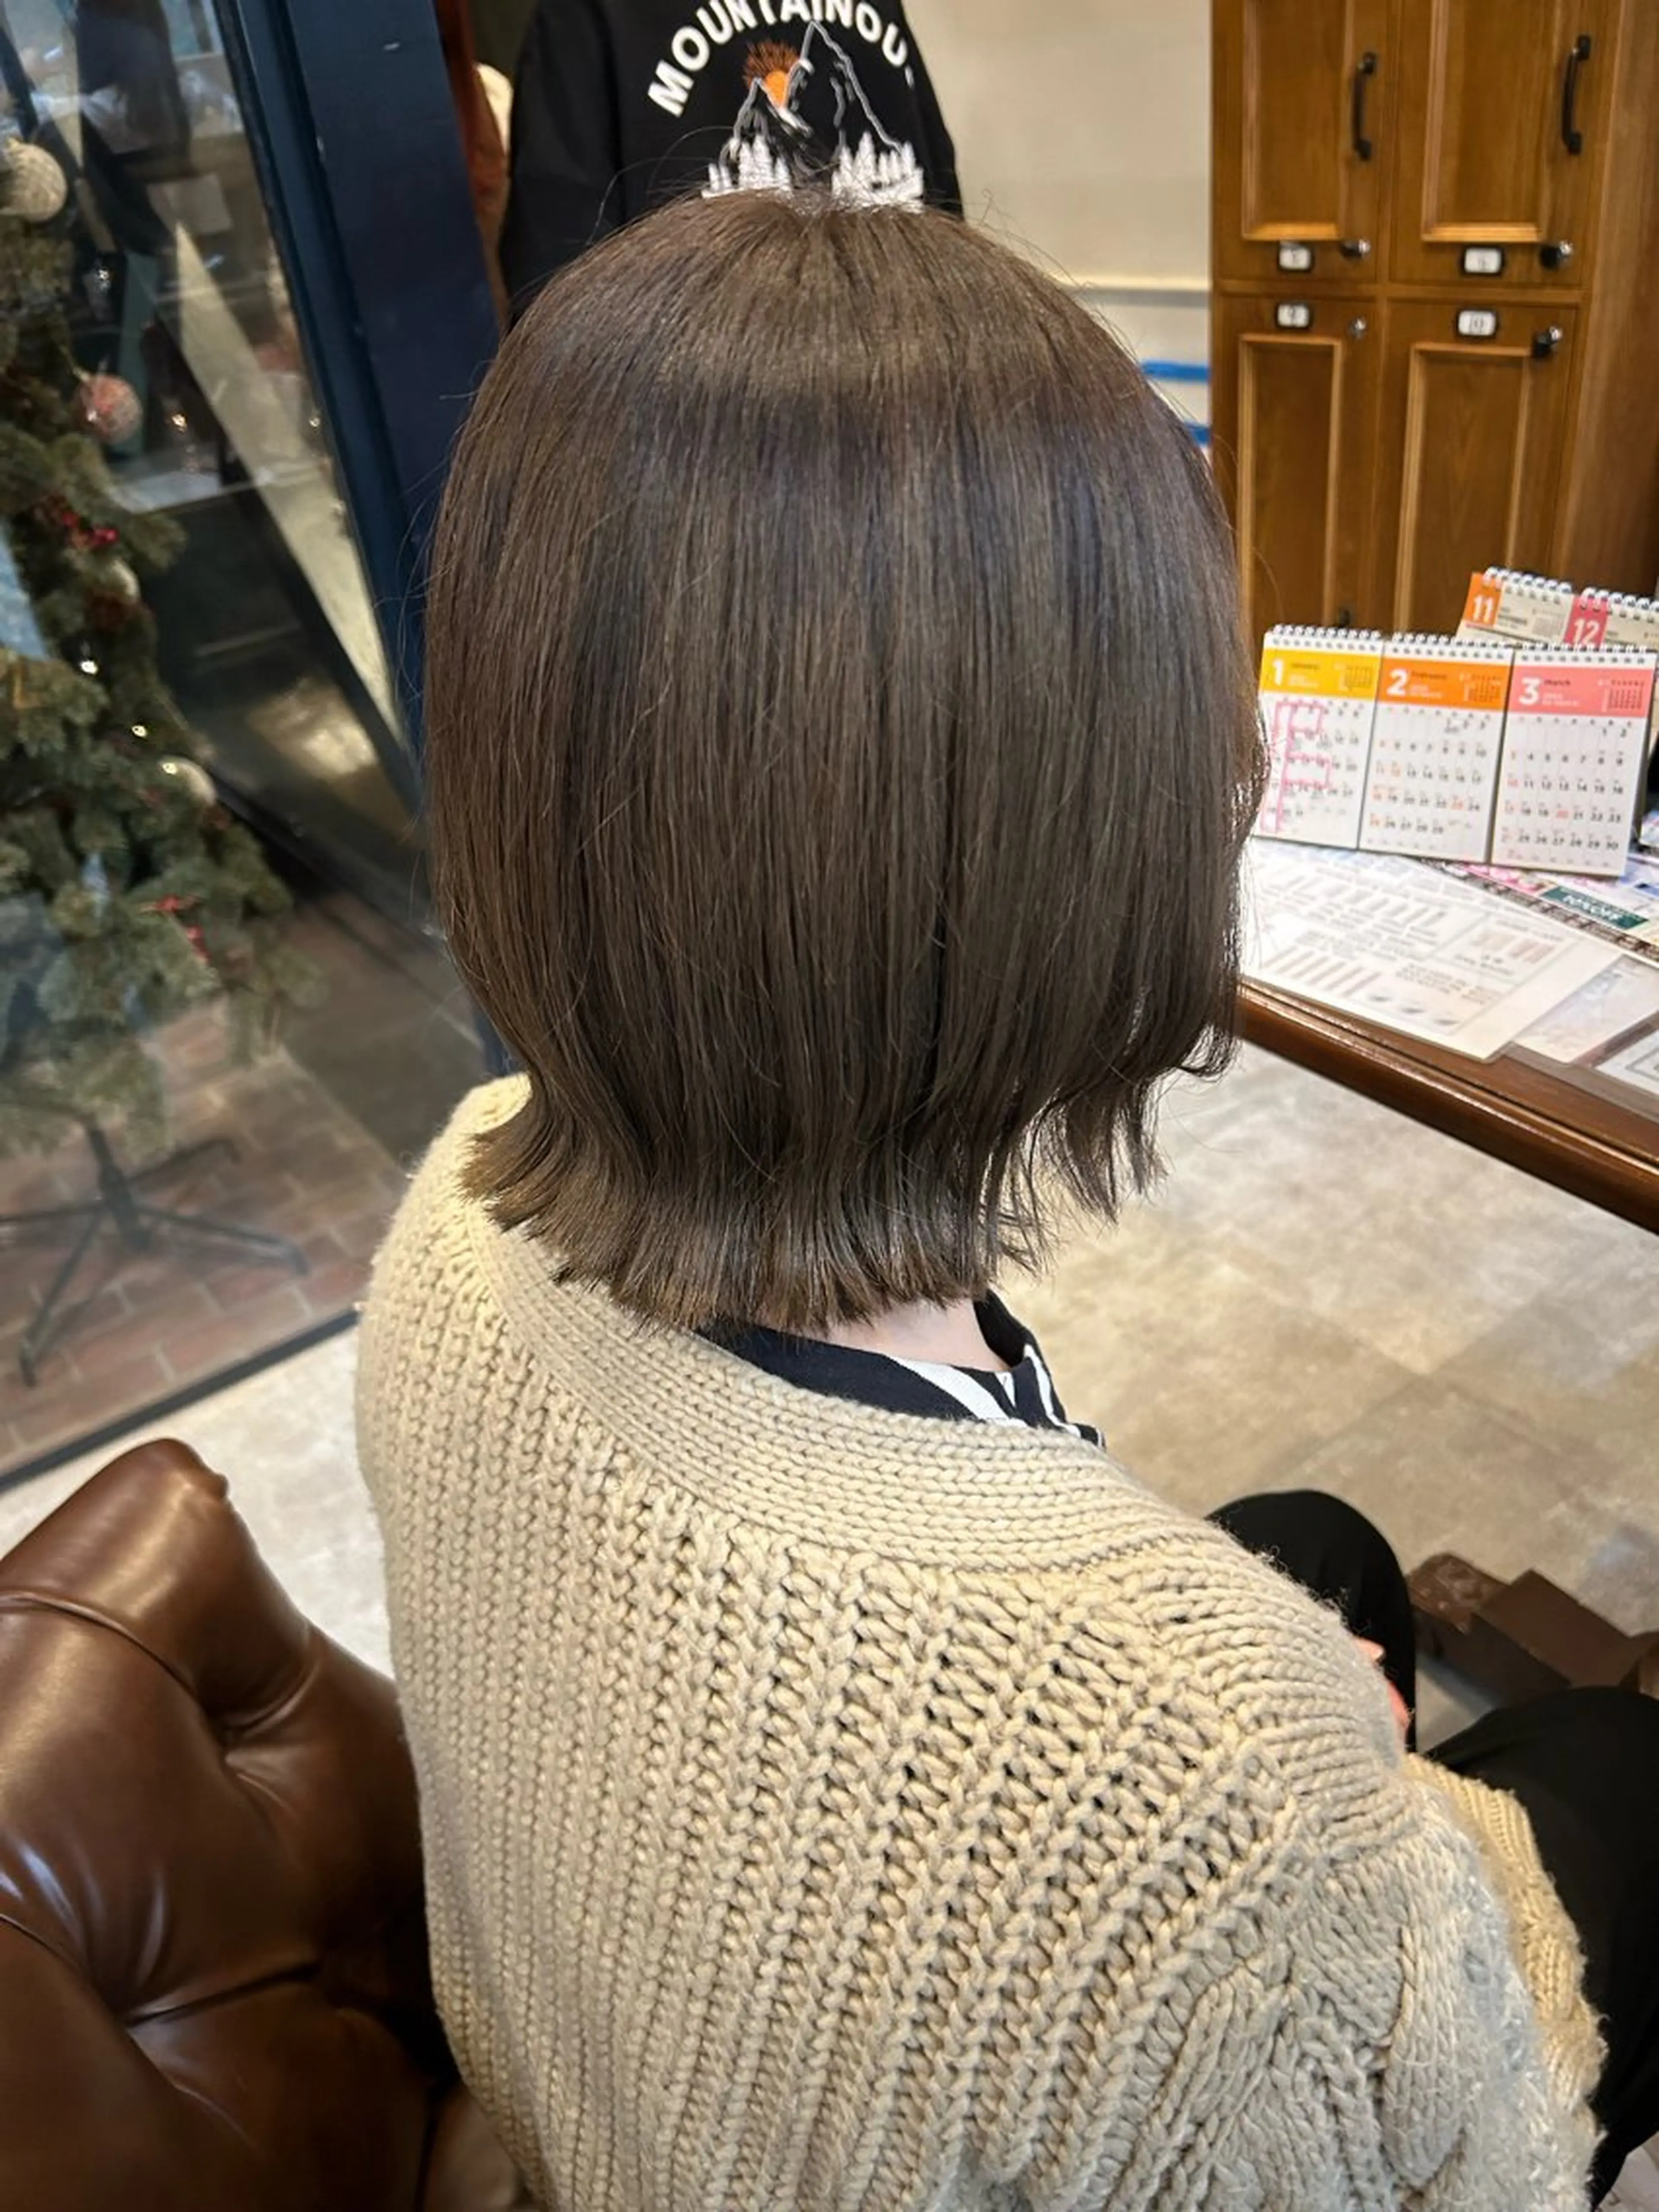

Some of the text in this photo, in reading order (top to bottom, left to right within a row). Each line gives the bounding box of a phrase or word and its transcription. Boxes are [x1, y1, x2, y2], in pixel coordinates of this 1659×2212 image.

[648, 0, 915, 117] MOUNTAINOU
[1473, 595, 1493, 623] 11
[1573, 619, 1600, 644] 12
[1273, 659, 1284, 685] 1
[1386, 669, 1408, 696] 2
[1519, 677, 1540, 705] 3
